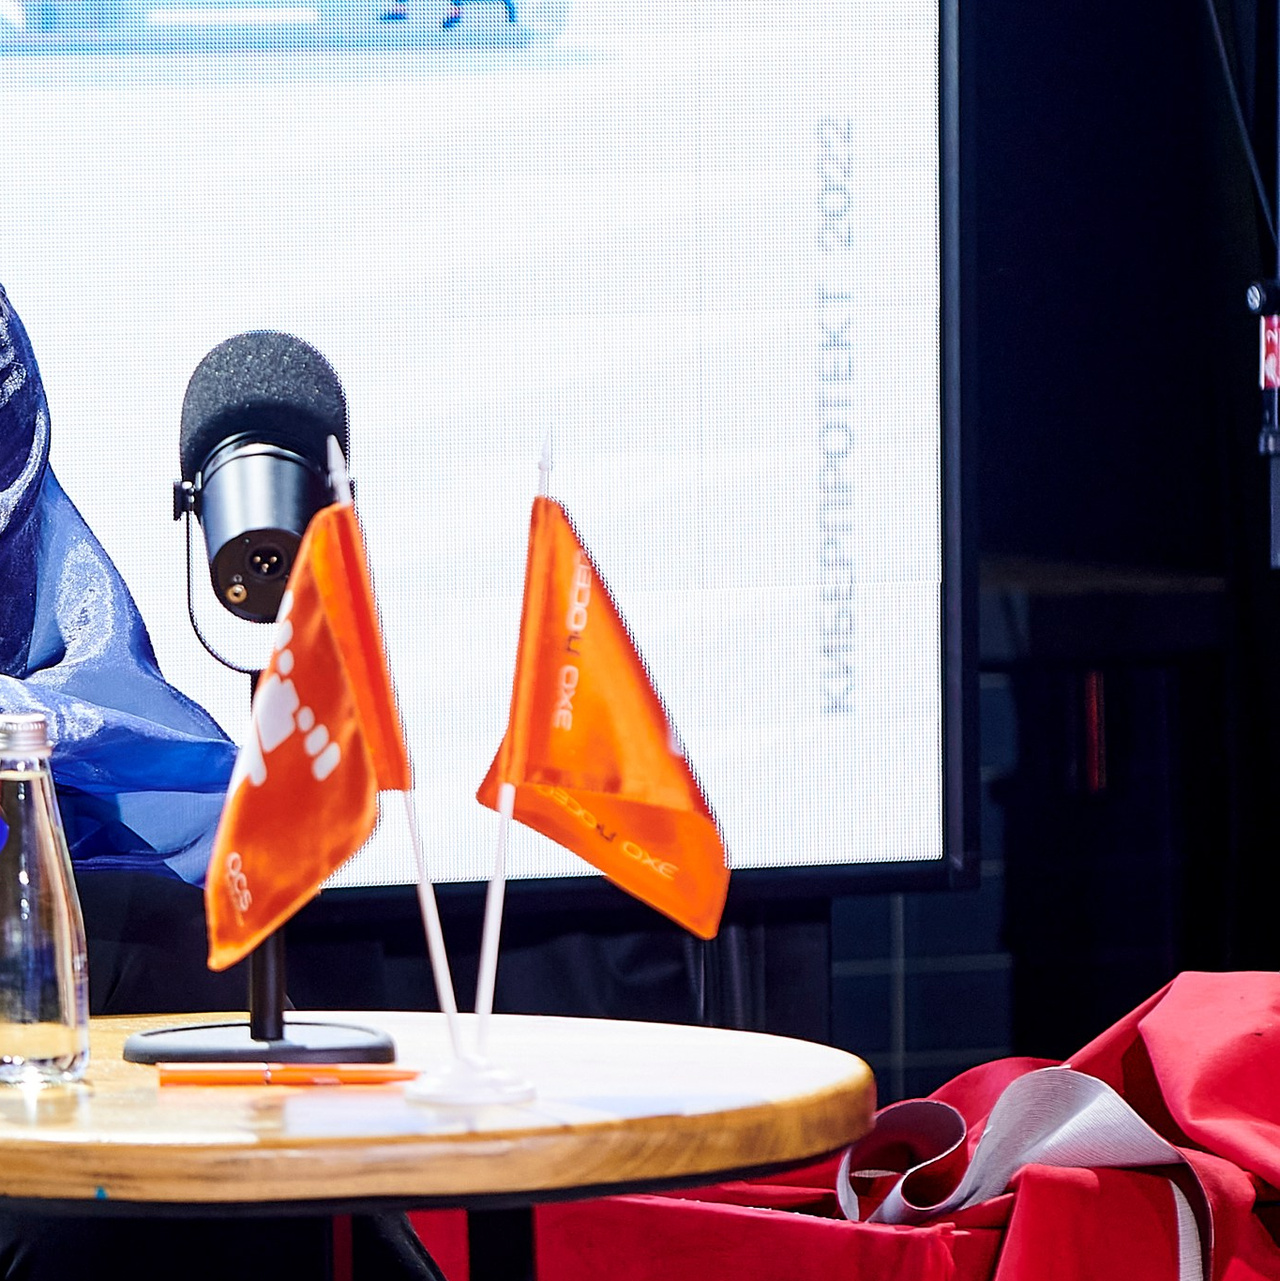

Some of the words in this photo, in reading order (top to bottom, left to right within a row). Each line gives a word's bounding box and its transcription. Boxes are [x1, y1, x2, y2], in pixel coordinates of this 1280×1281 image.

[816, 116, 854, 253] 2022
[816, 287, 854, 716] КИБЕРПРОТЕКТ
[226, 851, 253, 913] OCS
